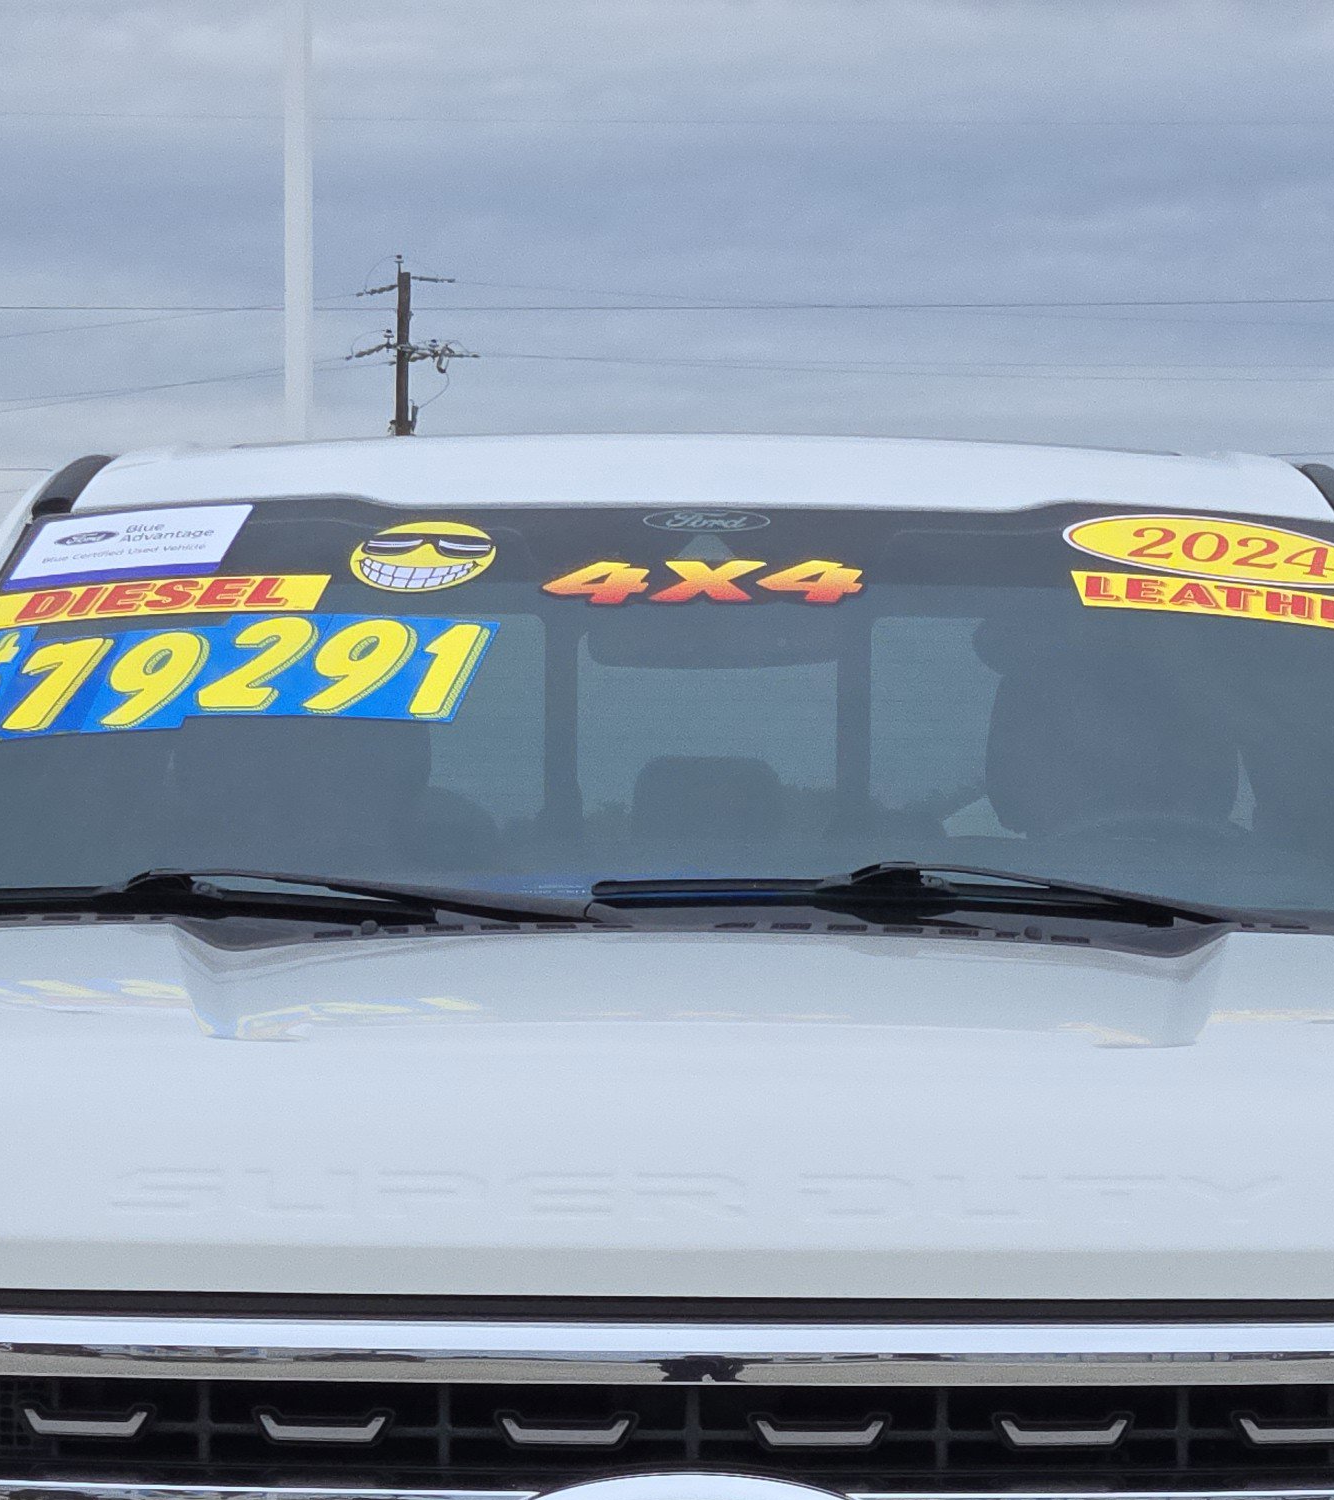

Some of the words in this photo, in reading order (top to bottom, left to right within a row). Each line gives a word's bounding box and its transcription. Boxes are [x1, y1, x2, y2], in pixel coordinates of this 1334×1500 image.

[126, 523, 165, 533] Blue
[665, 512, 748, 529] Ford
[119, 529, 215, 543] Advantage
[14, 576, 289, 622] DIESEL
[108, 1166, 749, 1224] SUPER
[798, 1171, 1285, 1226] DUTY
